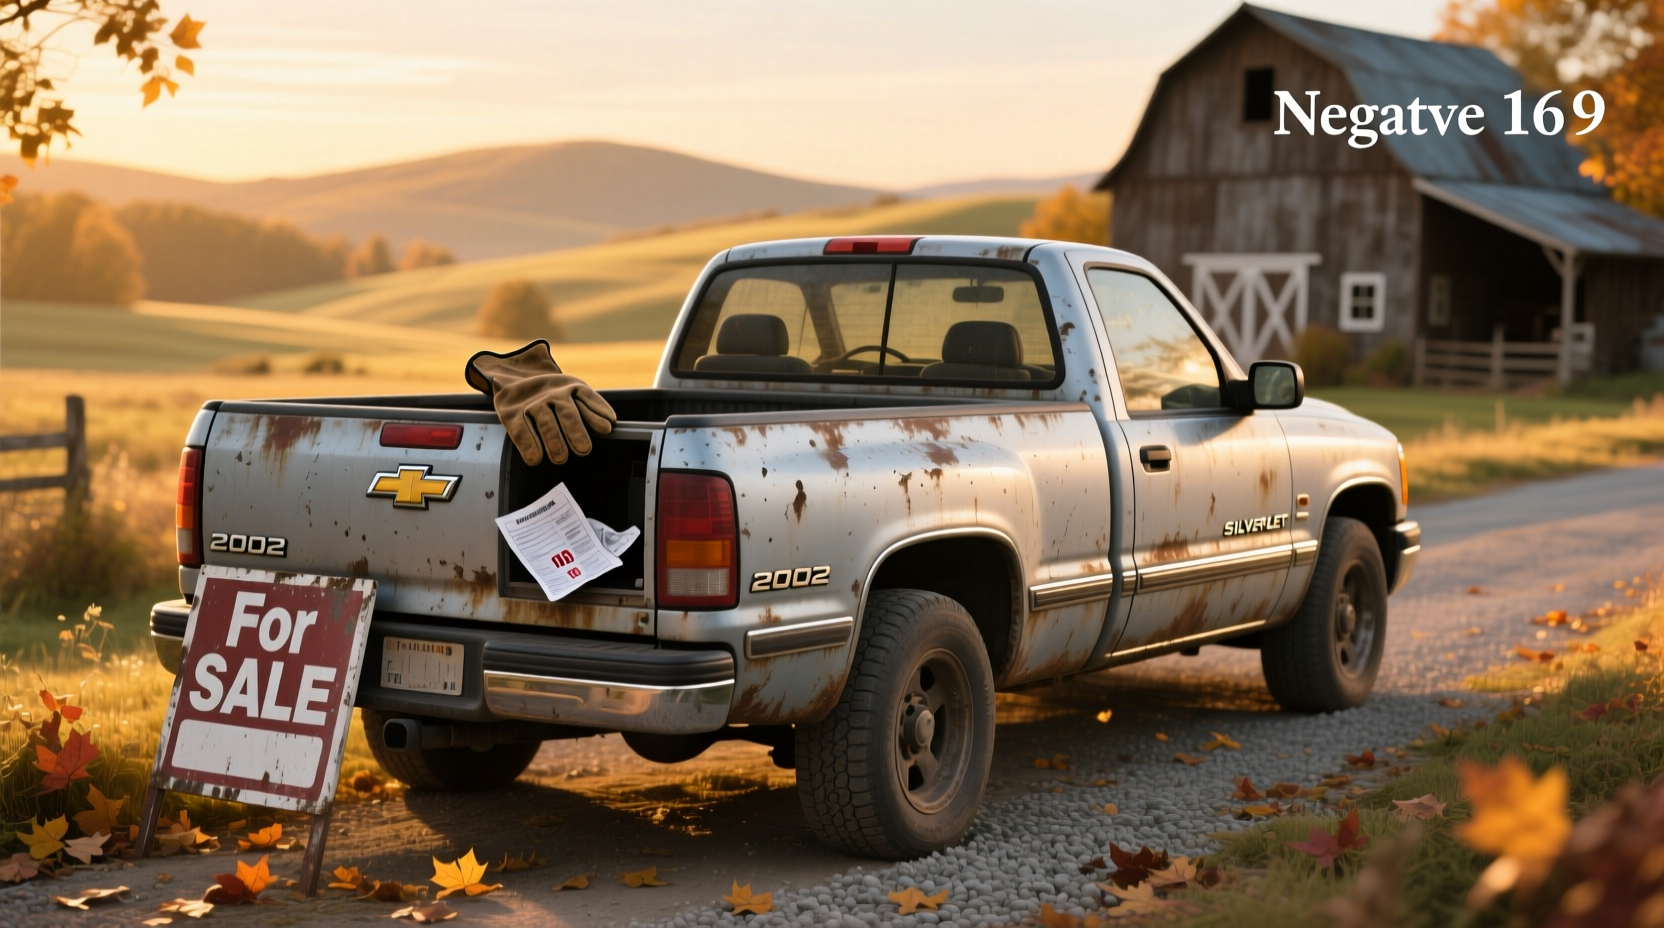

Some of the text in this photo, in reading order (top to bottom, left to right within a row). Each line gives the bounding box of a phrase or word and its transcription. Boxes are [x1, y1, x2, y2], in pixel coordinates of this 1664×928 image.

[210, 533, 286, 556] 2002
[751, 565, 831, 592] 2002
[225, 590, 318, 654] For
[189, 653, 337, 726] SALE
